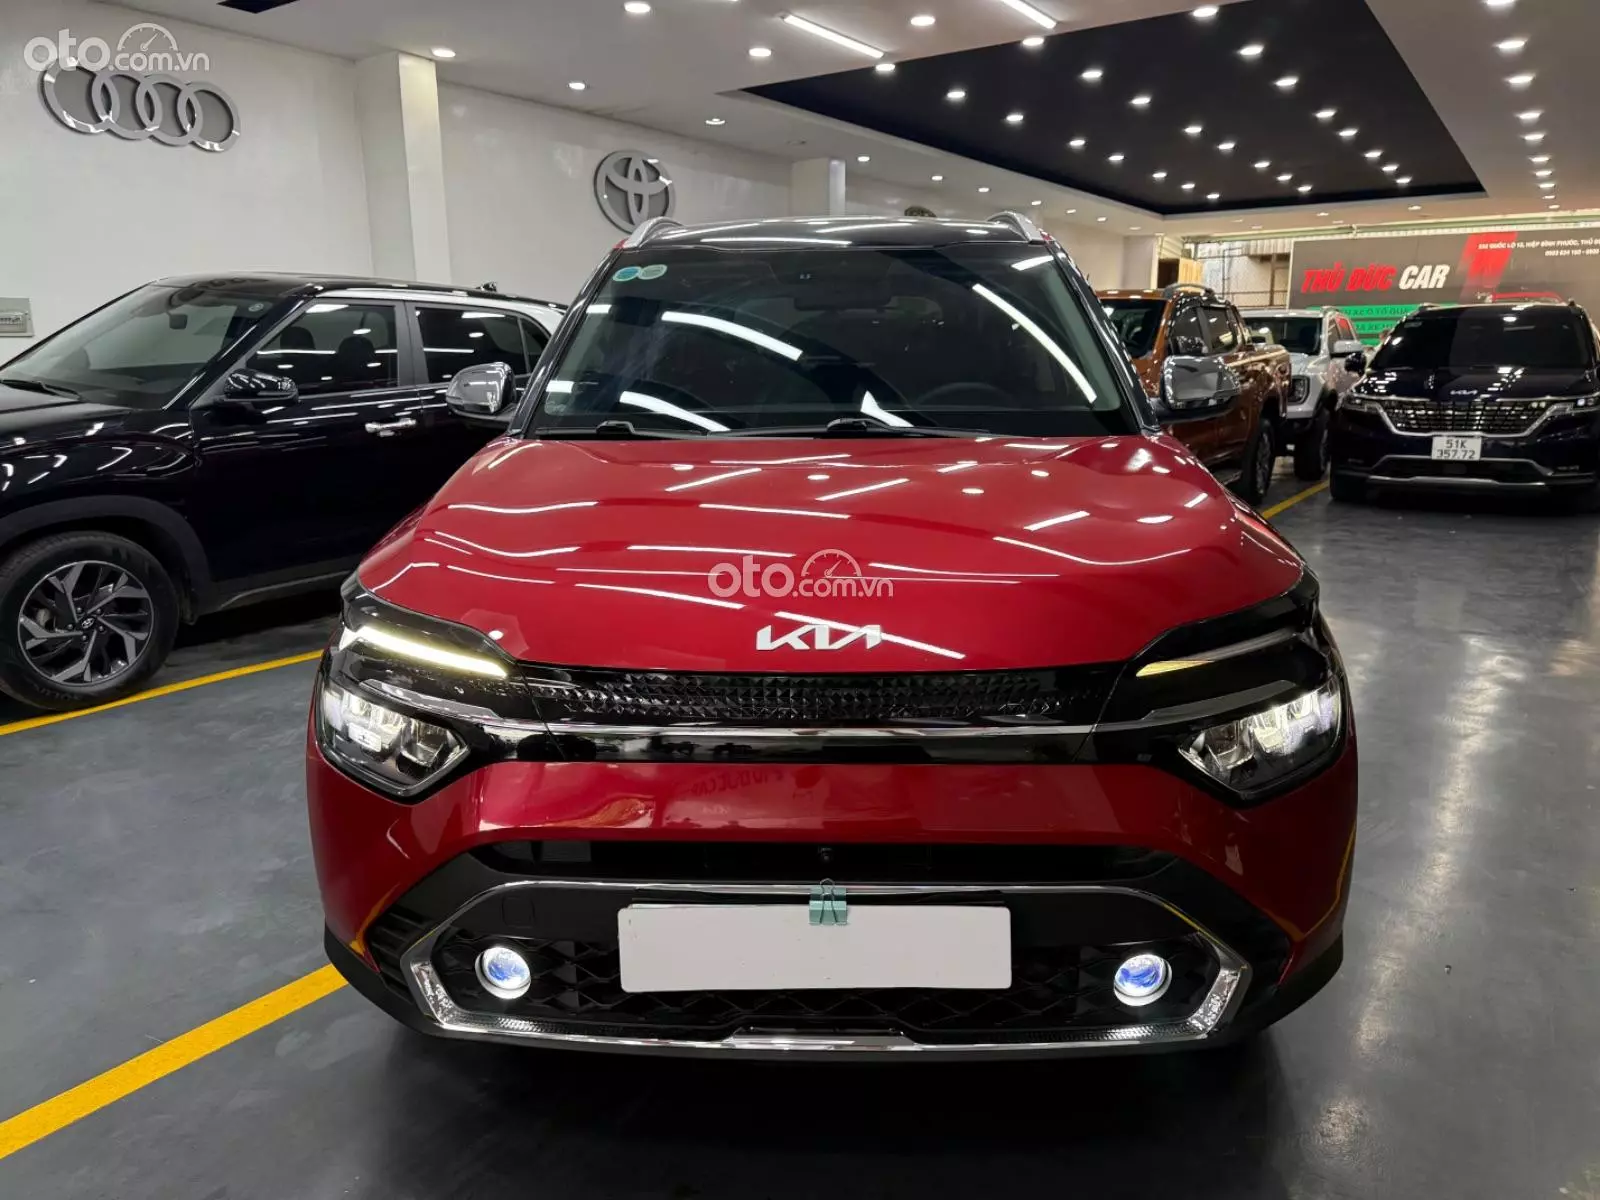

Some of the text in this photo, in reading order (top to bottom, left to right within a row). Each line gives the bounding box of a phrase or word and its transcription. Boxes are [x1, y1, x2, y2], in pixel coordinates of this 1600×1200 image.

[1301, 261, 1346, 293] THỦ
[1399, 264, 1451, 290] CAR
[1446, 439, 1467, 448] 51K
[756, 624, 881, 650] KIA
